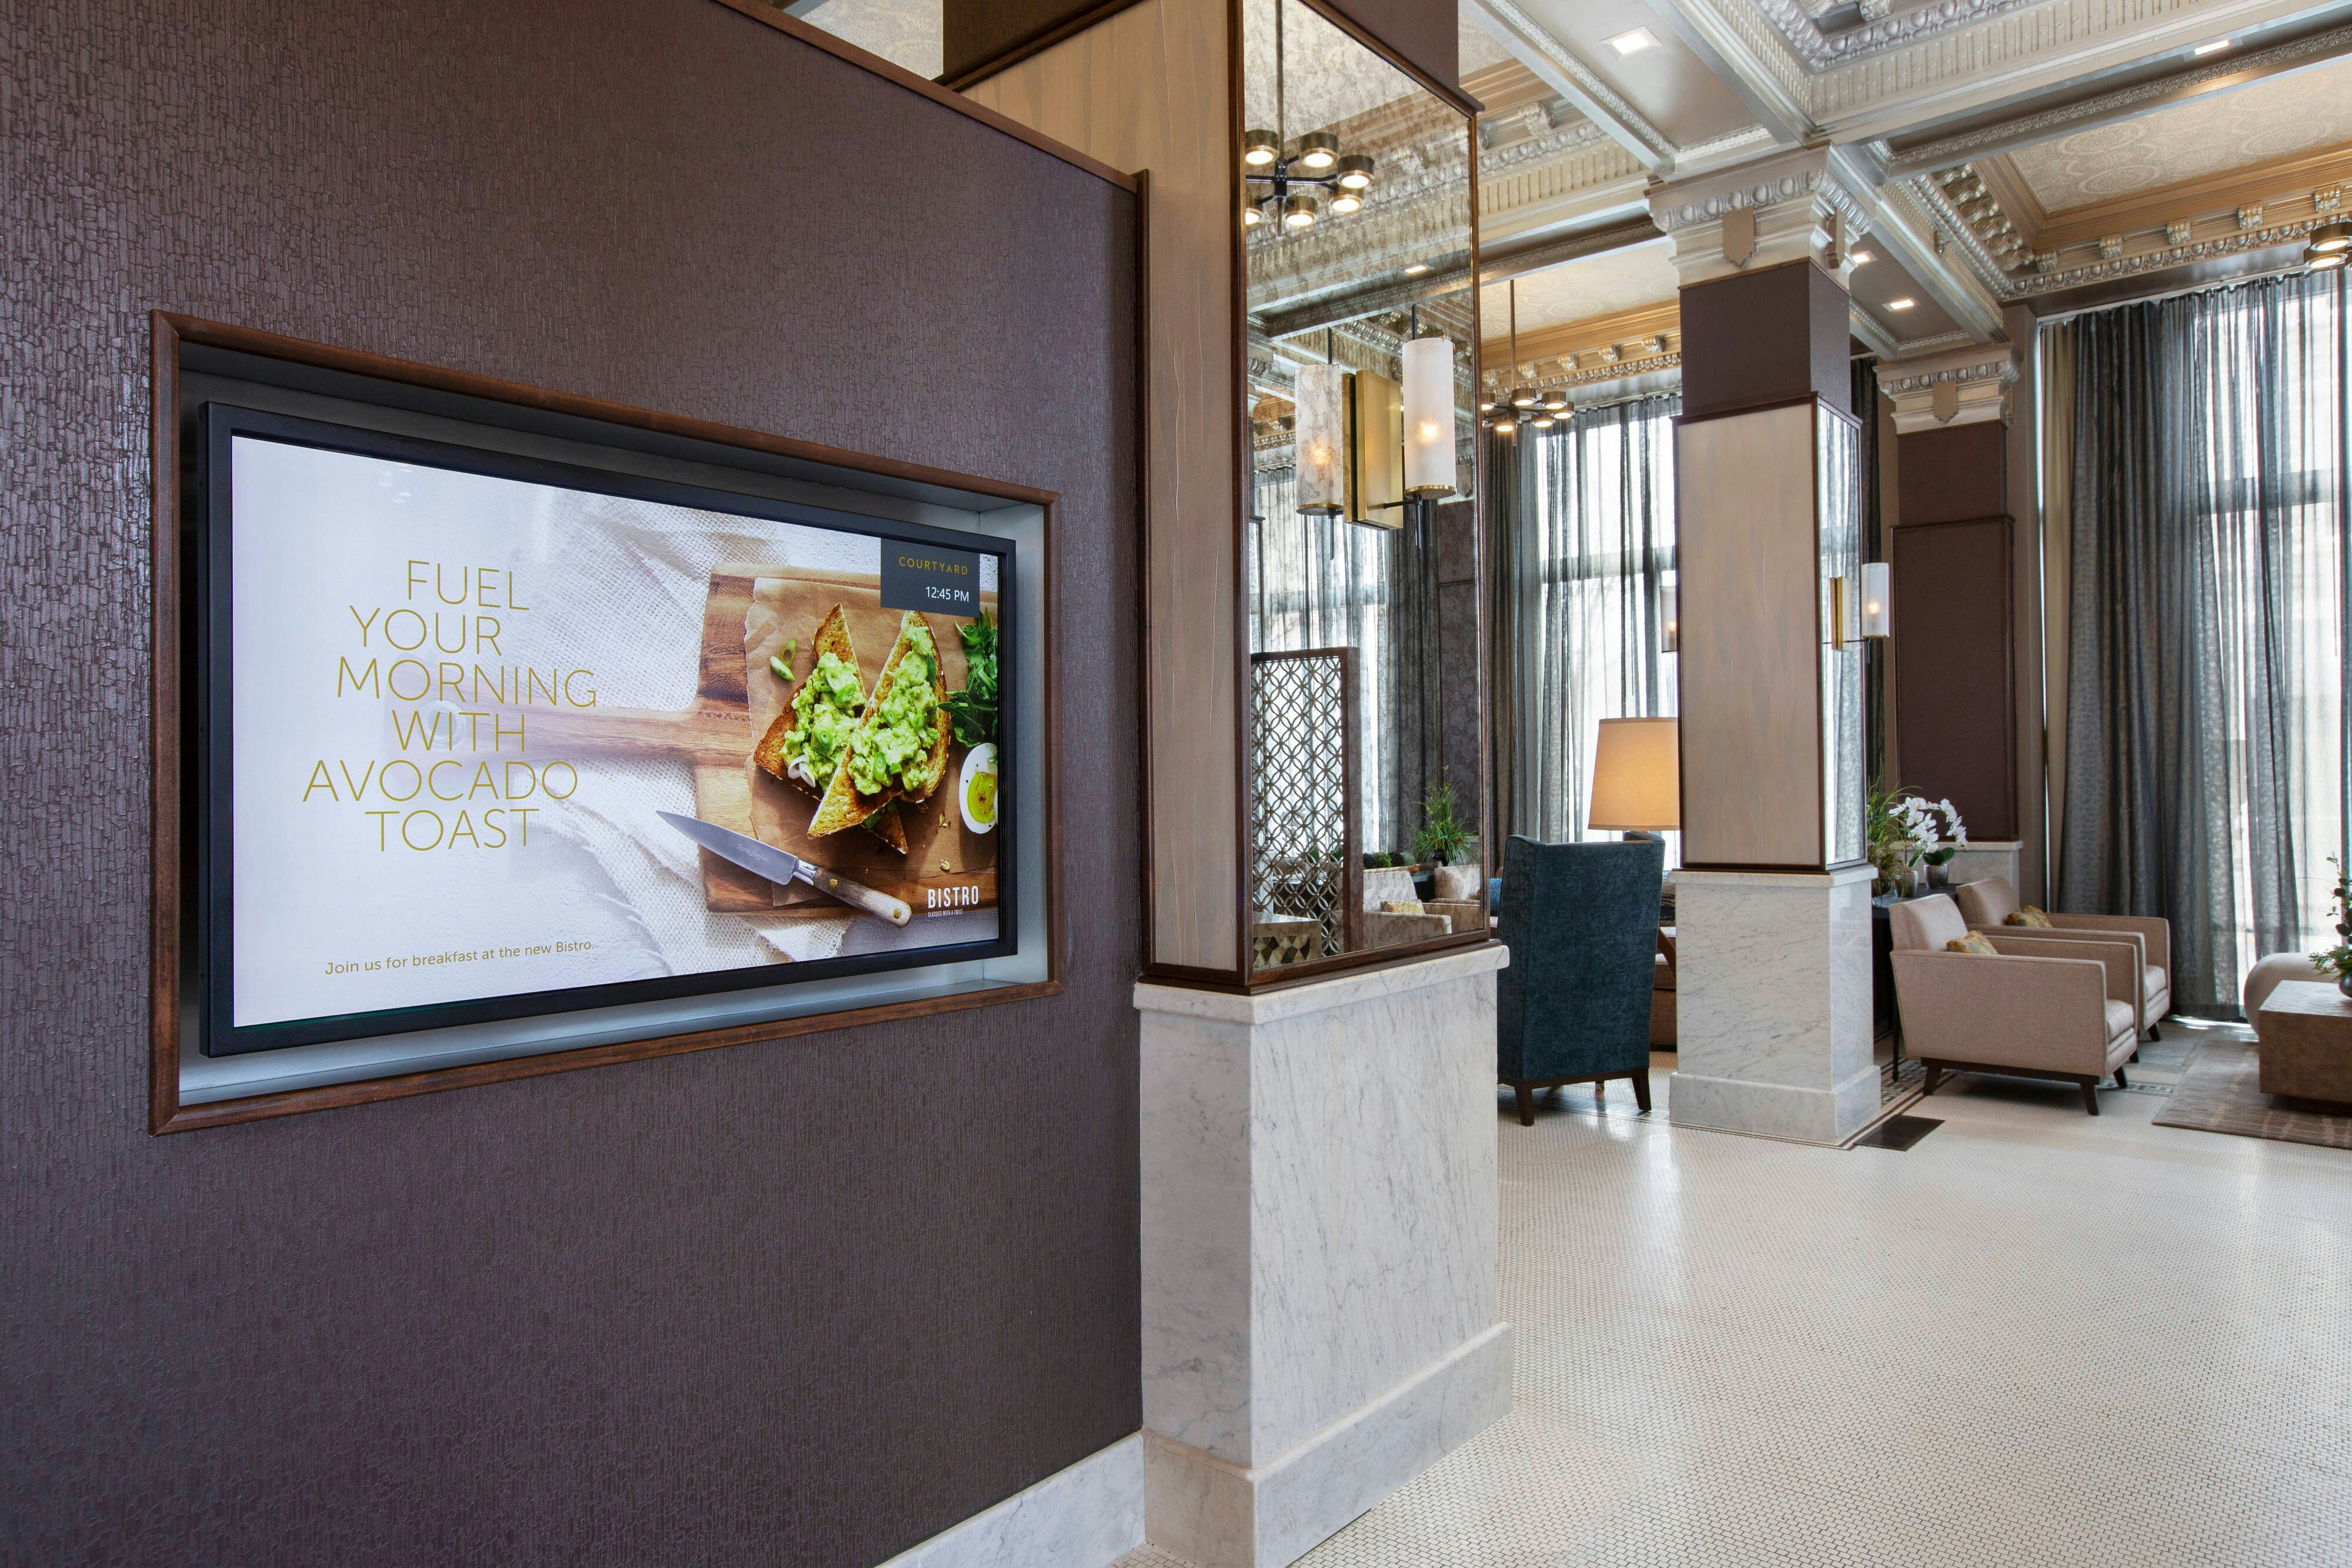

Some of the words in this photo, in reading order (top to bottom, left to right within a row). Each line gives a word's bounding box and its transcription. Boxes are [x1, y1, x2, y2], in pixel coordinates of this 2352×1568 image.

[408, 560, 529, 610] FUEL
[898, 556, 969, 575] COURTYARD
[926, 586, 951, 600] 12:45
[954, 590, 969, 603] PM
[349, 605, 502, 656] YOUR
[338, 656, 597, 707] MORNING
[392, 710, 524, 753] WITH
[303, 760, 577, 802] AVOCADO
[365, 808, 539, 852] TOAST
[927, 885, 979, 909] BISTRO
[325, 961, 359, 975] Join
[365, 961, 382, 971] us
[386, 957, 407, 969] for
[412, 951, 477, 967] breakfast
[482, 949, 495, 960] at
[499, 947, 520, 958] the
[525, 945, 552, 955] new
[556, 941, 594, 952] Bistro.
